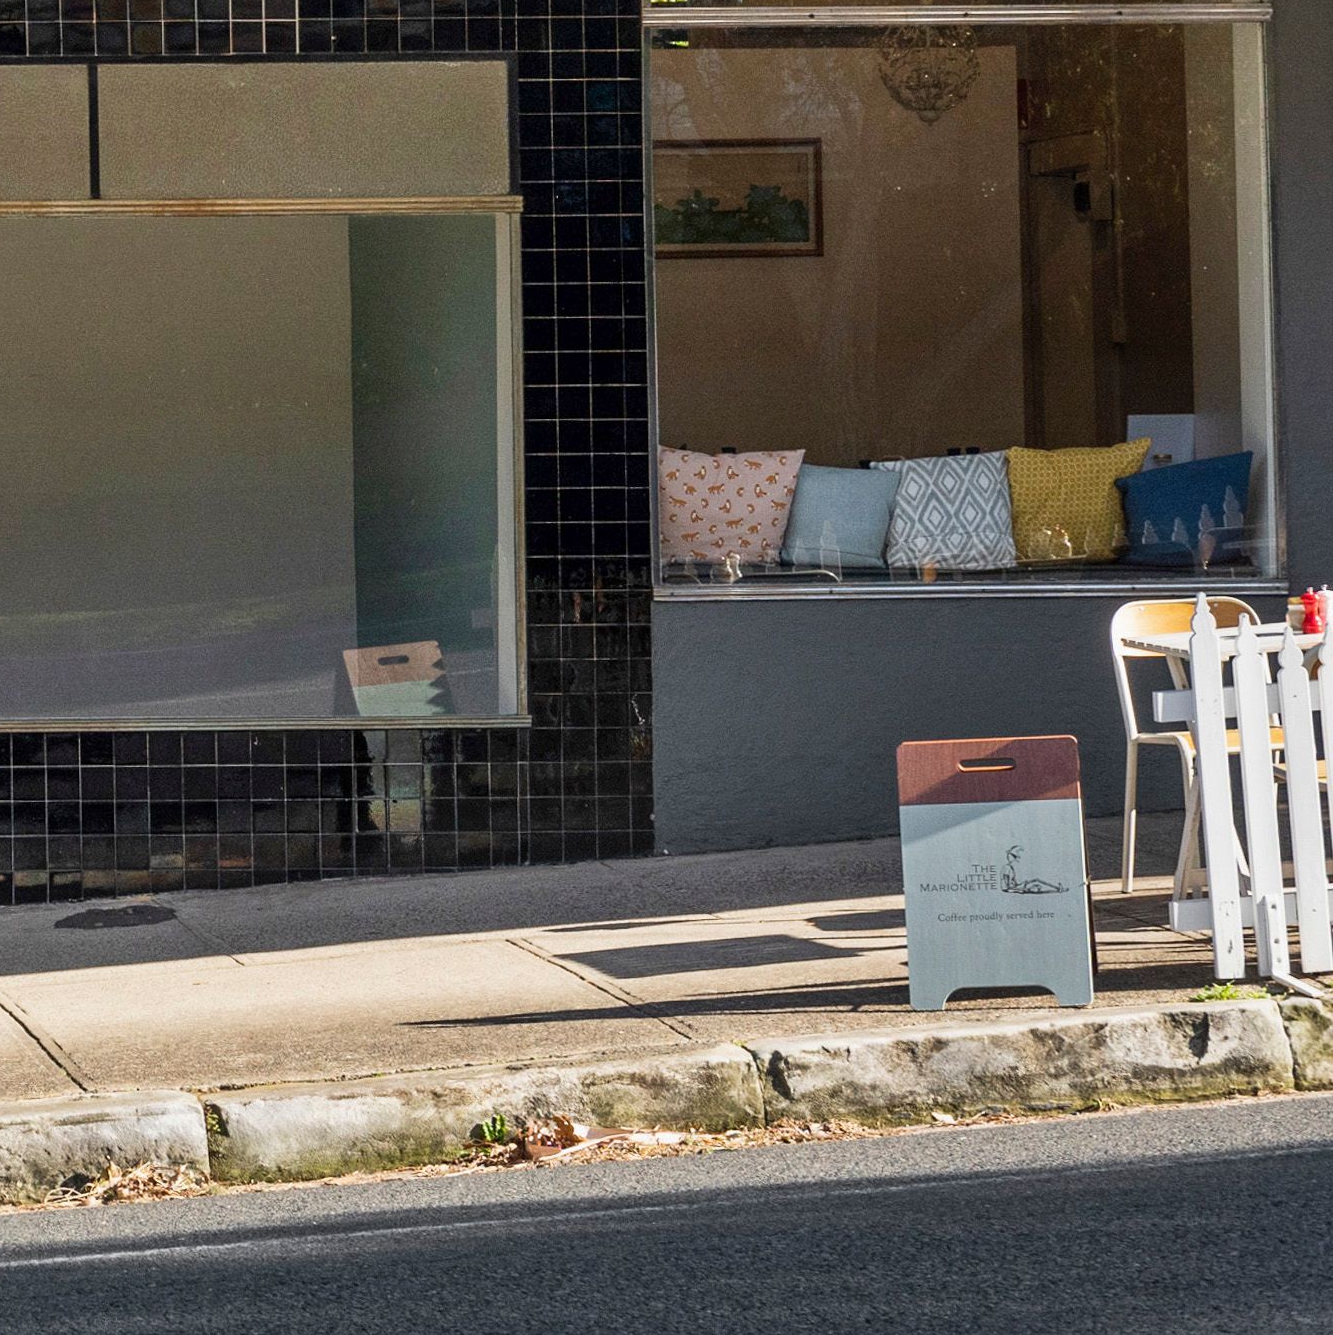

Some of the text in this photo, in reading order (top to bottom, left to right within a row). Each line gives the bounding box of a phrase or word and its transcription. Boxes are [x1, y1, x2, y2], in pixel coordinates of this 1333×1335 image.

[971, 864, 997, 873] THE
[956, 873, 997, 883] LITTLE
[919, 882, 998, 893] MARIONETTE
[937, 910, 1055, 923] Coffee proudly served here
